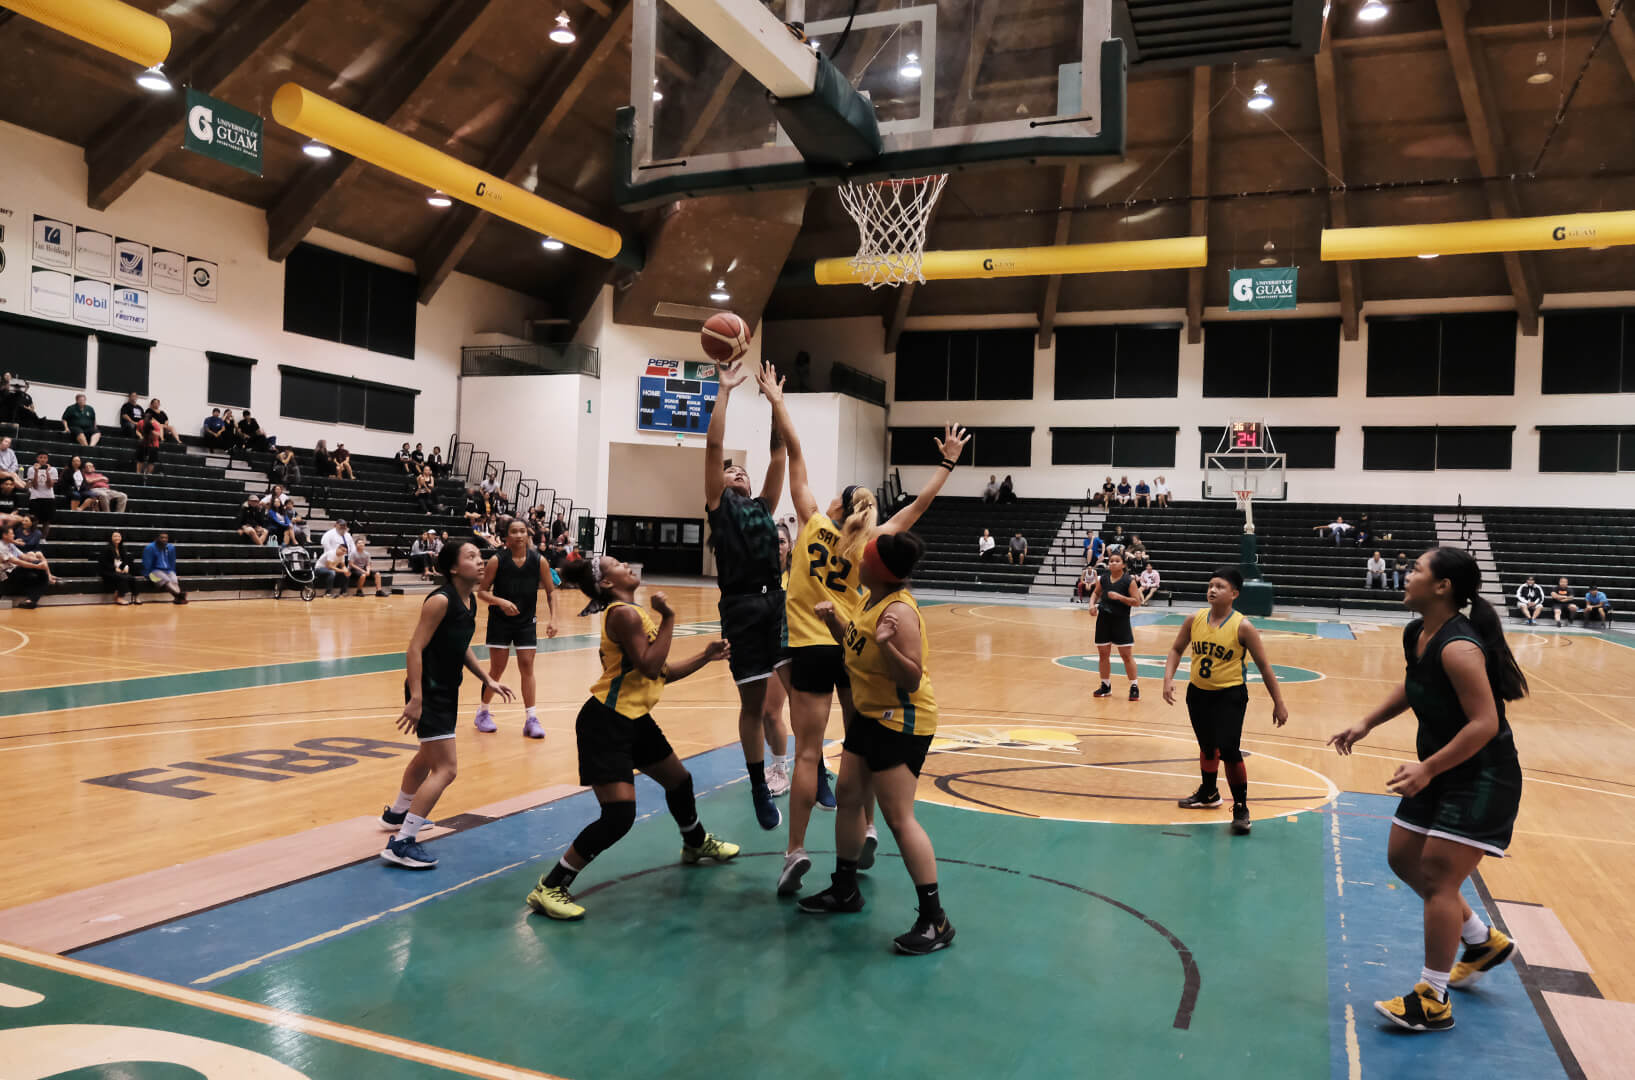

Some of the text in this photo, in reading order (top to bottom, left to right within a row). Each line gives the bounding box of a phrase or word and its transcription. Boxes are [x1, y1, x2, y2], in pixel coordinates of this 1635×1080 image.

[217, 117, 259, 139] UNIVERSITY OF
[217, 126, 258, 152] GUAM
[1256, 285, 1293, 295] GUAM
[74, 293, 107, 309] Mobil
[648, 358, 679, 368] PEPSI
[586, 400, 592, 414] 1
[1237, 432, 1257, 448] 24
[807, 542, 852, 593] 22
[1198, 657, 1213, 679] 8
[80, 736, 421, 801] FIBA
